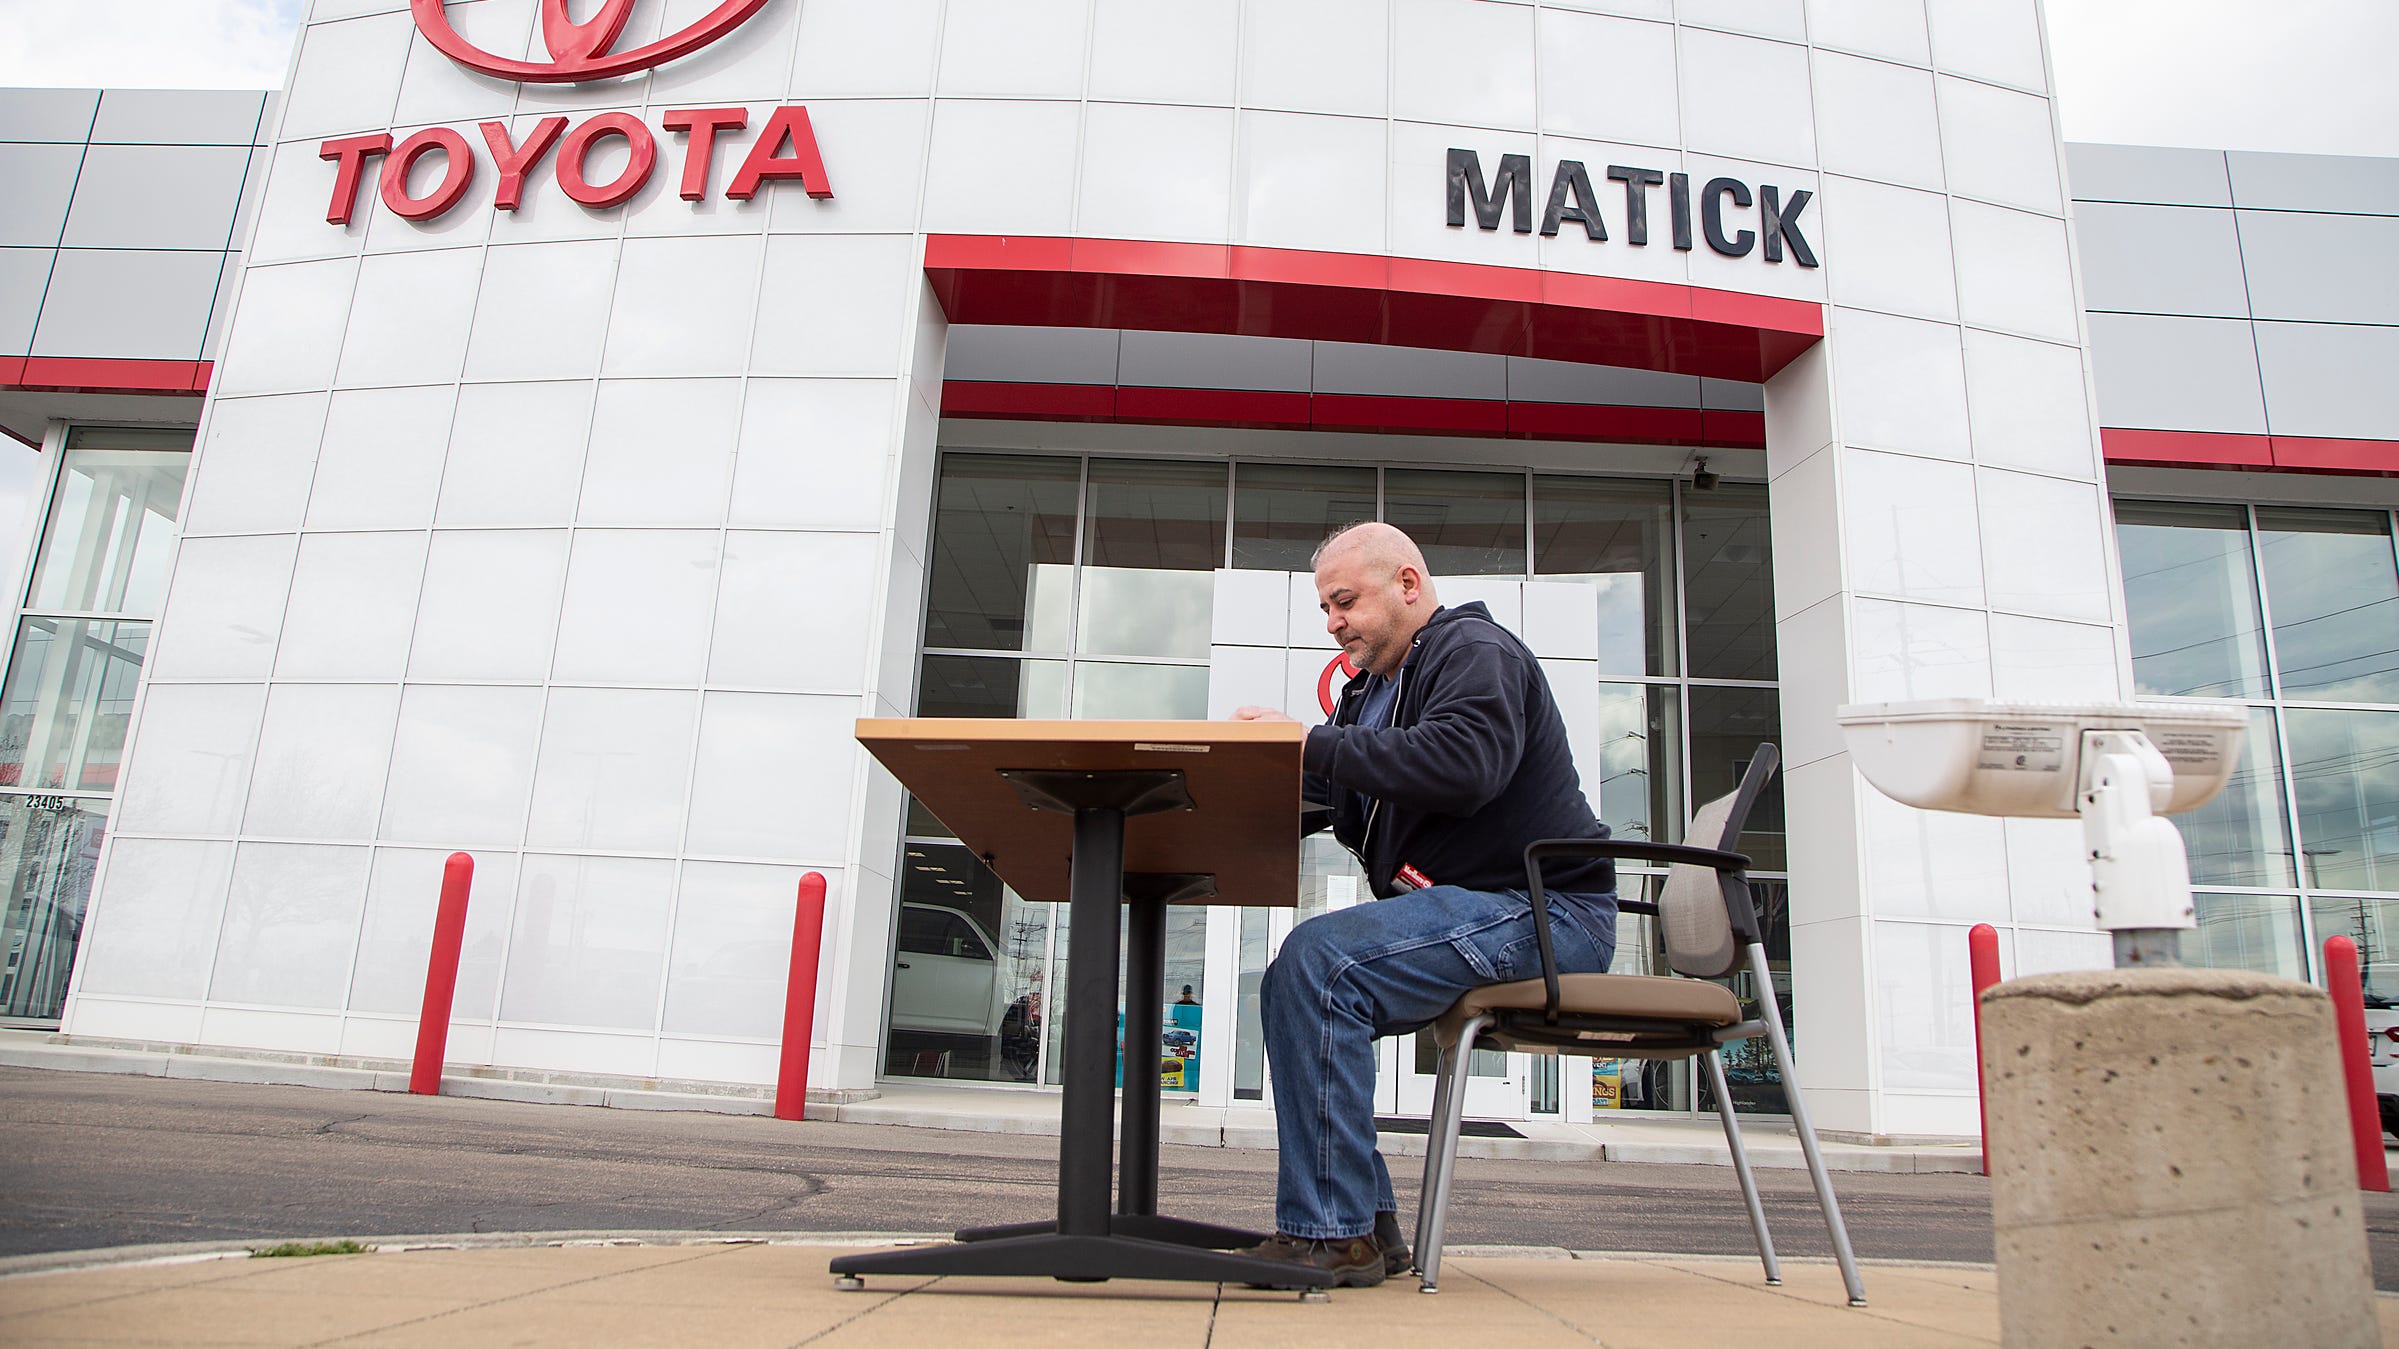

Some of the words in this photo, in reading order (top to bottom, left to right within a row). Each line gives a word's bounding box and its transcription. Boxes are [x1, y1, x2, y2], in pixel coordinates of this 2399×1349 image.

[319, 105, 834, 225] TOYOTA
[1446, 147, 1819, 268] MATICK
[26, 795, 63, 809] 23405
[1593, 1087, 1615, 1097] NGS
